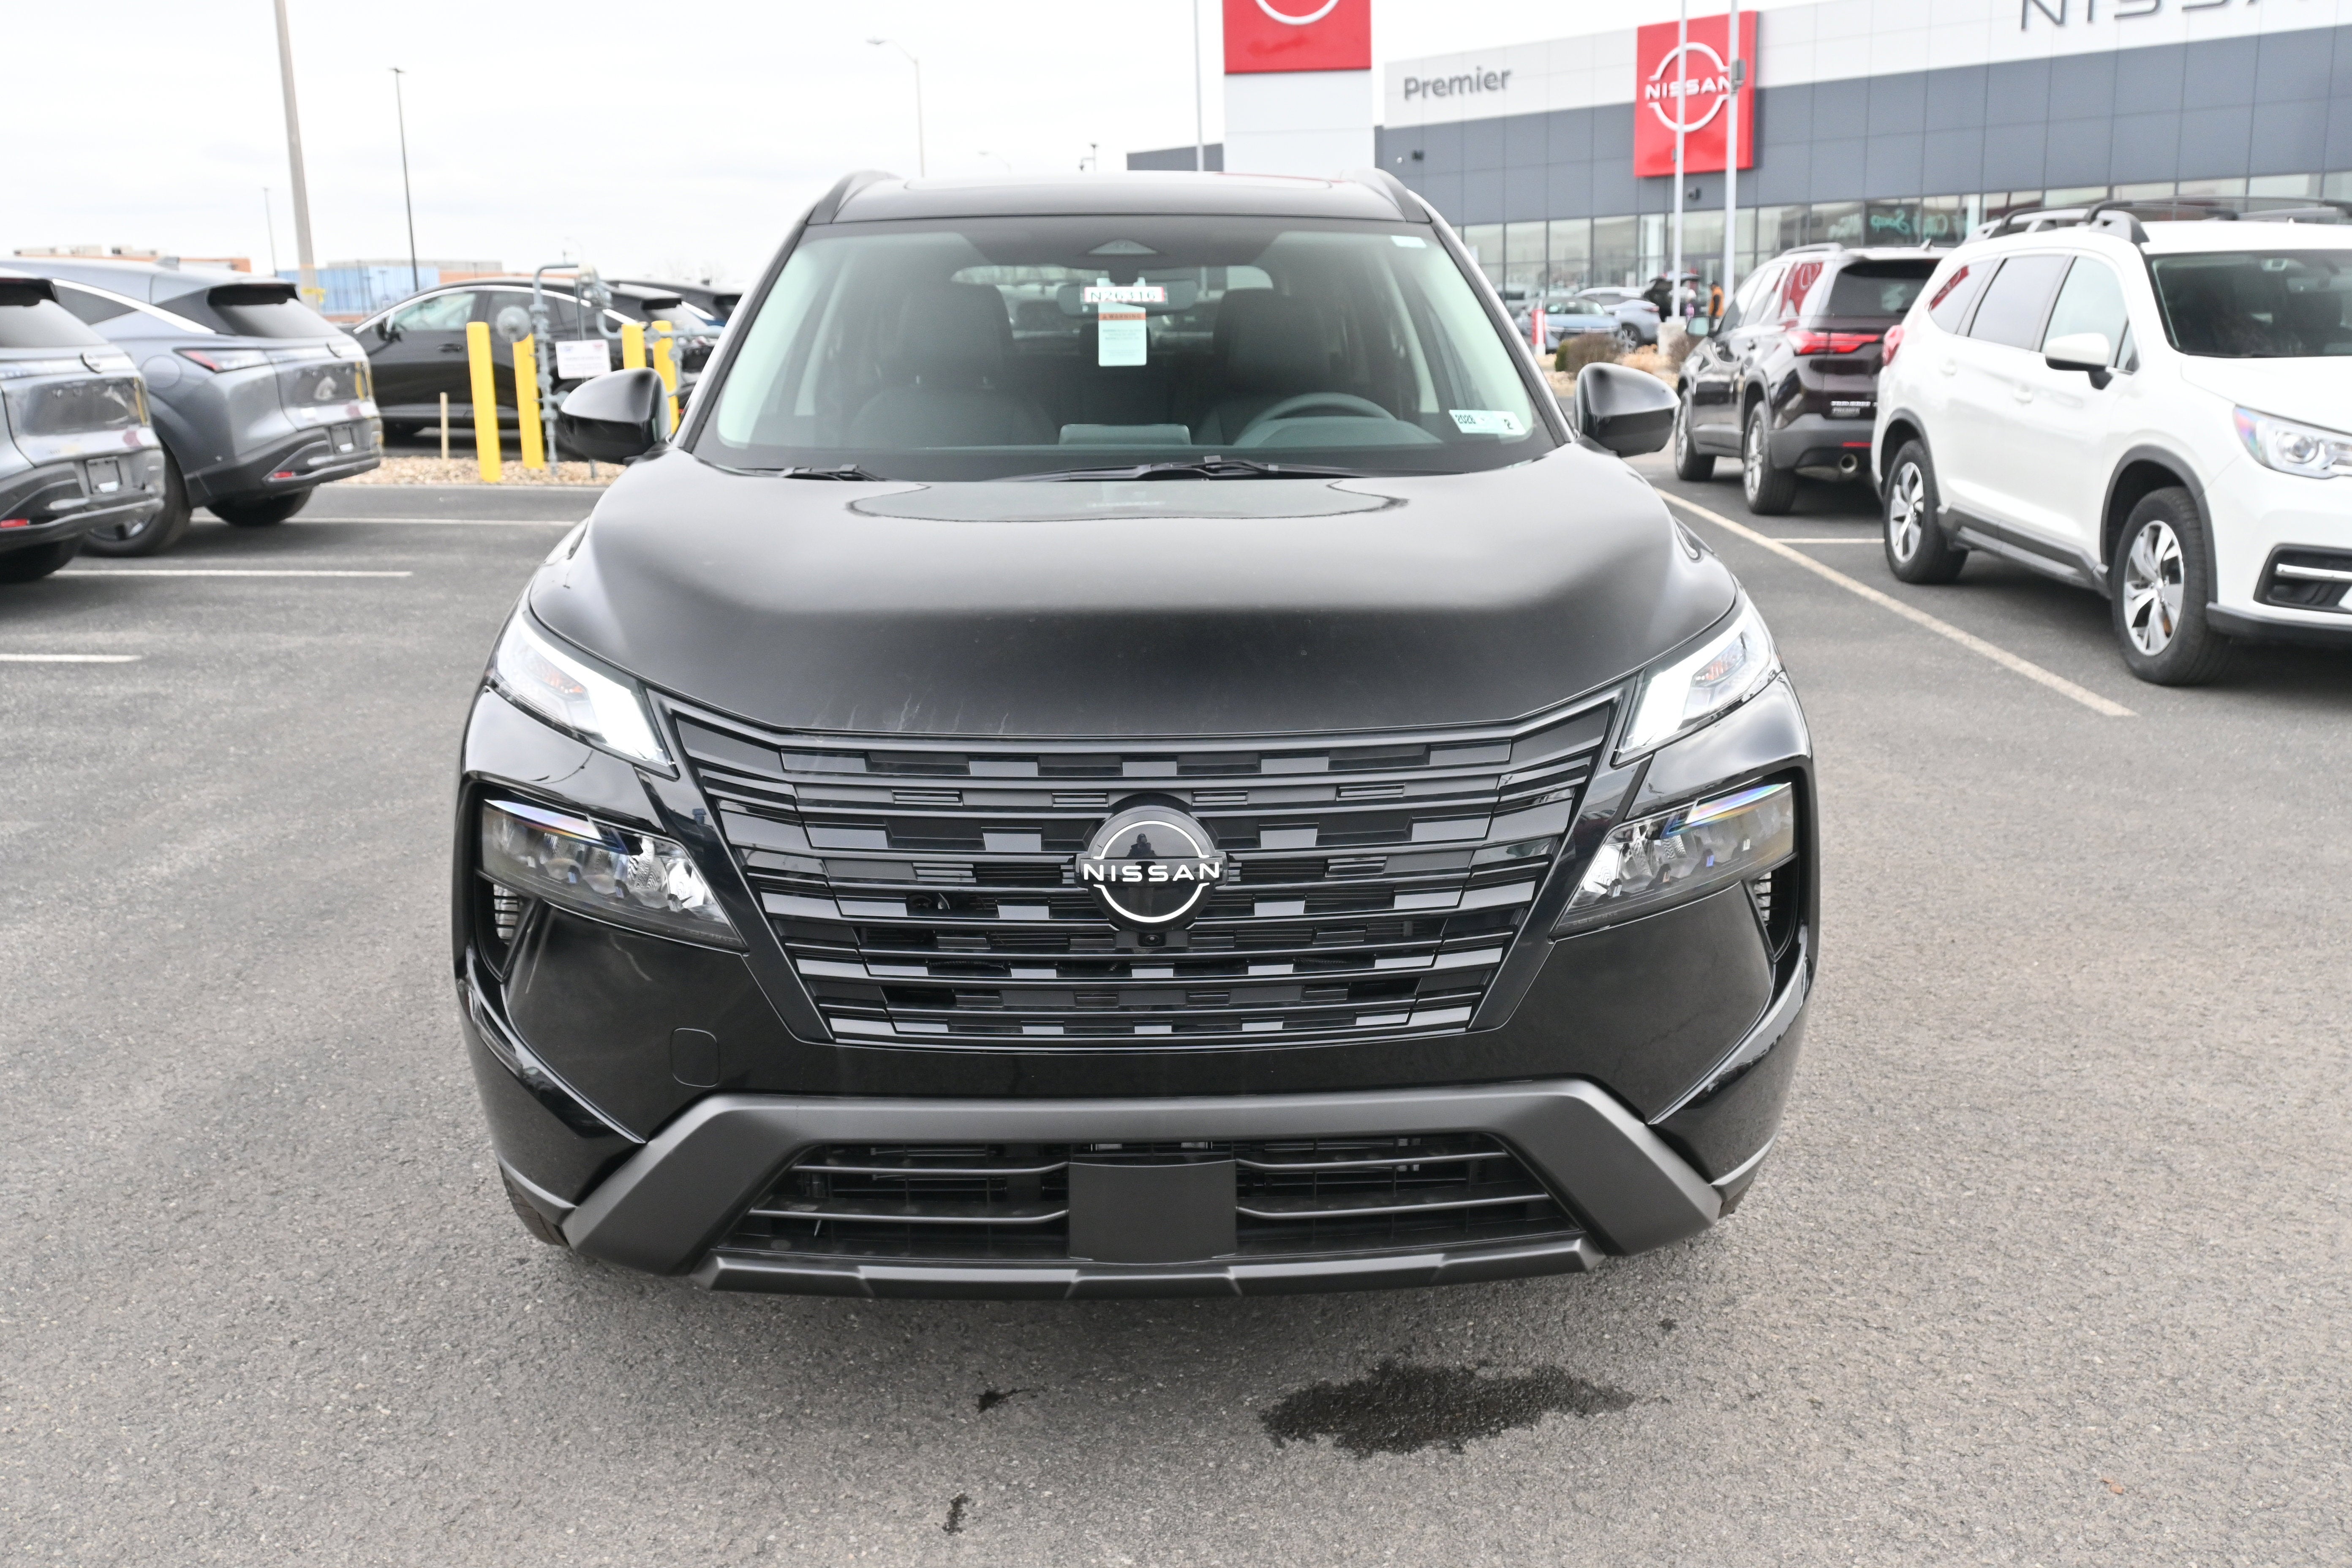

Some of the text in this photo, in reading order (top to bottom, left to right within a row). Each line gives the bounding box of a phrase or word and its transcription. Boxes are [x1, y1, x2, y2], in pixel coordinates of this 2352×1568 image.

[1404, 65, 1512, 100] Premier
[1645, 75, 1731, 100] NISSAN
[1091, 290, 1155, 302] N26316
[1083, 861, 1220, 882] NISSAN
